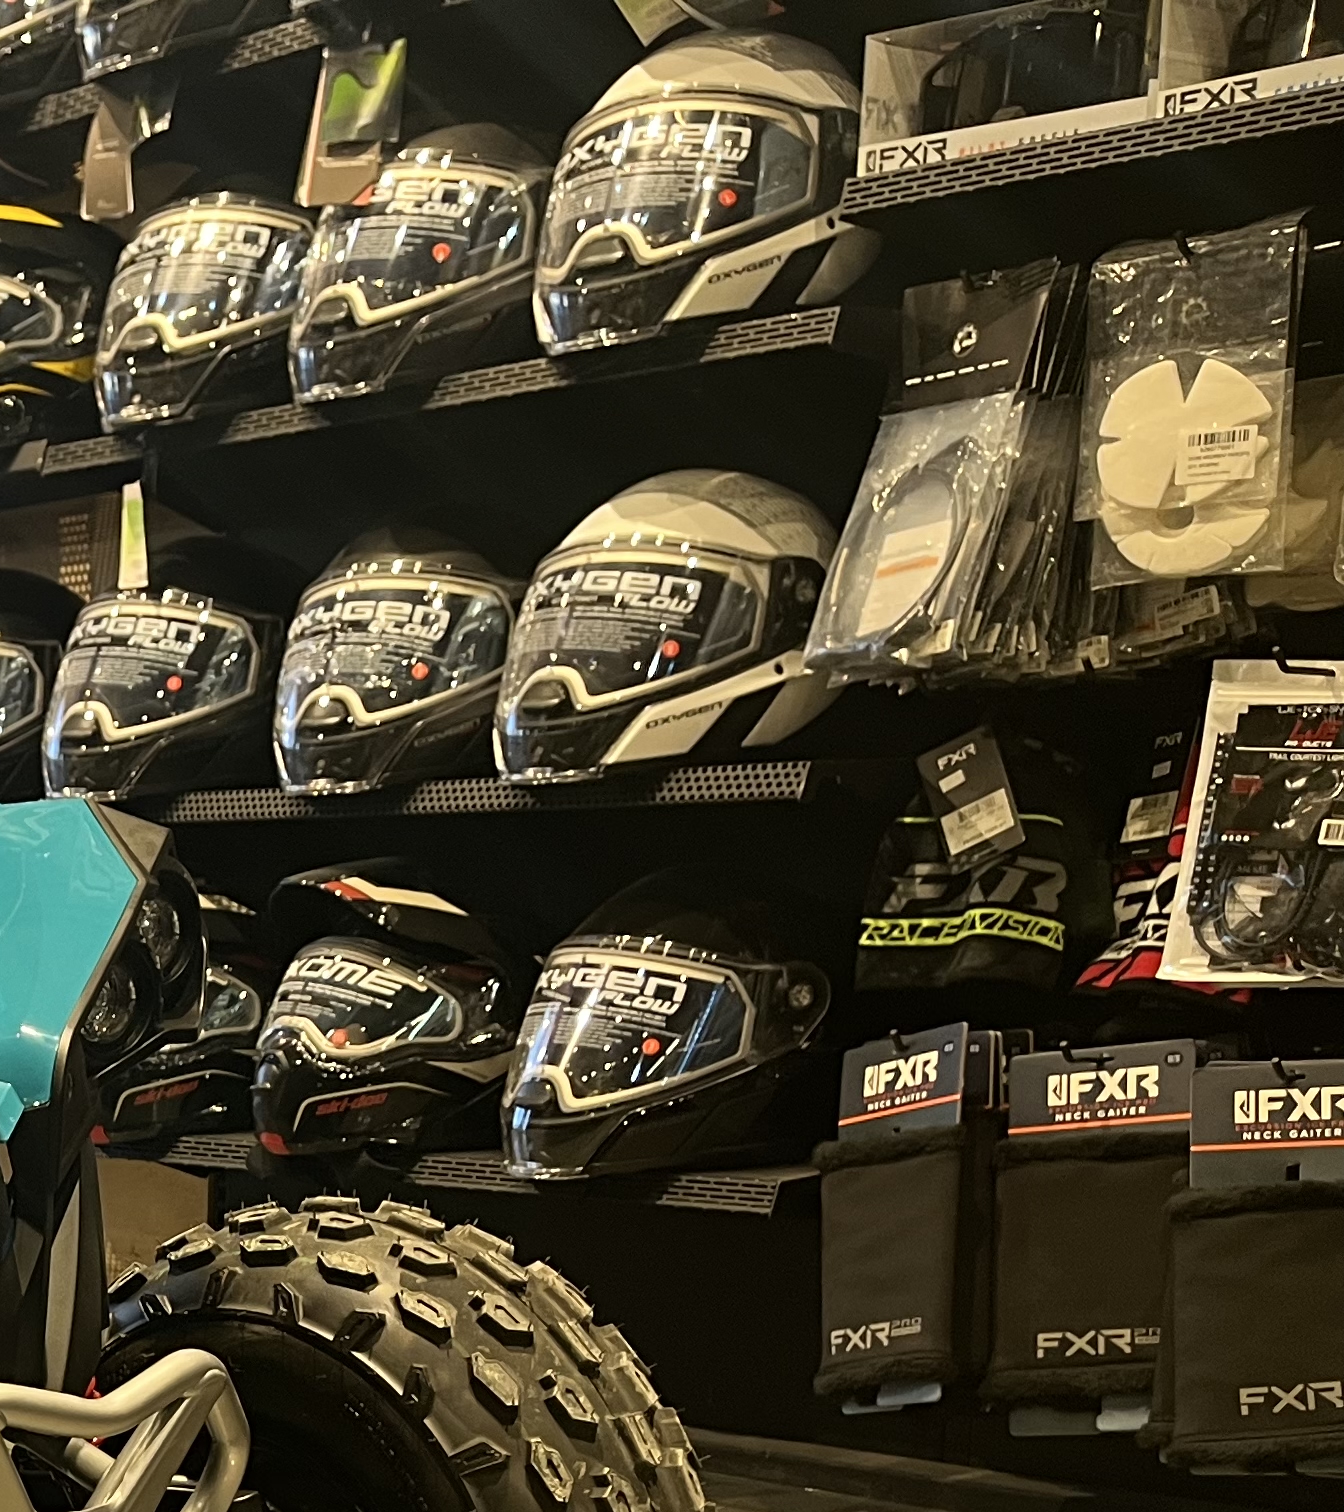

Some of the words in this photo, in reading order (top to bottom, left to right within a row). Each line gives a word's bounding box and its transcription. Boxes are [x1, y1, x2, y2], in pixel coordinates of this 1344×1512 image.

[1179, 77, 1258, 115] FXR
[879, 138, 947, 174] FXR
[384, 201, 468, 218] FLOW
[616, 592, 698, 614] FLOW
[937, 743, 976, 771] FXR
[597, 989, 682, 1016] FLOW
[877, 1050, 939, 1094] FXR
[1069, 1064, 1159, 1105] FXR
[1054, 1110, 1091, 1122] NECK
[1096, 1105, 1147, 1119] GAITER
[1258, 1085, 1344, 1123] FXR
[1242, 1130, 1282, 1141] NECK
[1288, 1127, 1342, 1139] GAITER
[830, 1321, 891, 1356] FXR
[1036, 1328, 1132, 1359] FXR
[1239, 1381, 1344, 1415] FXR
